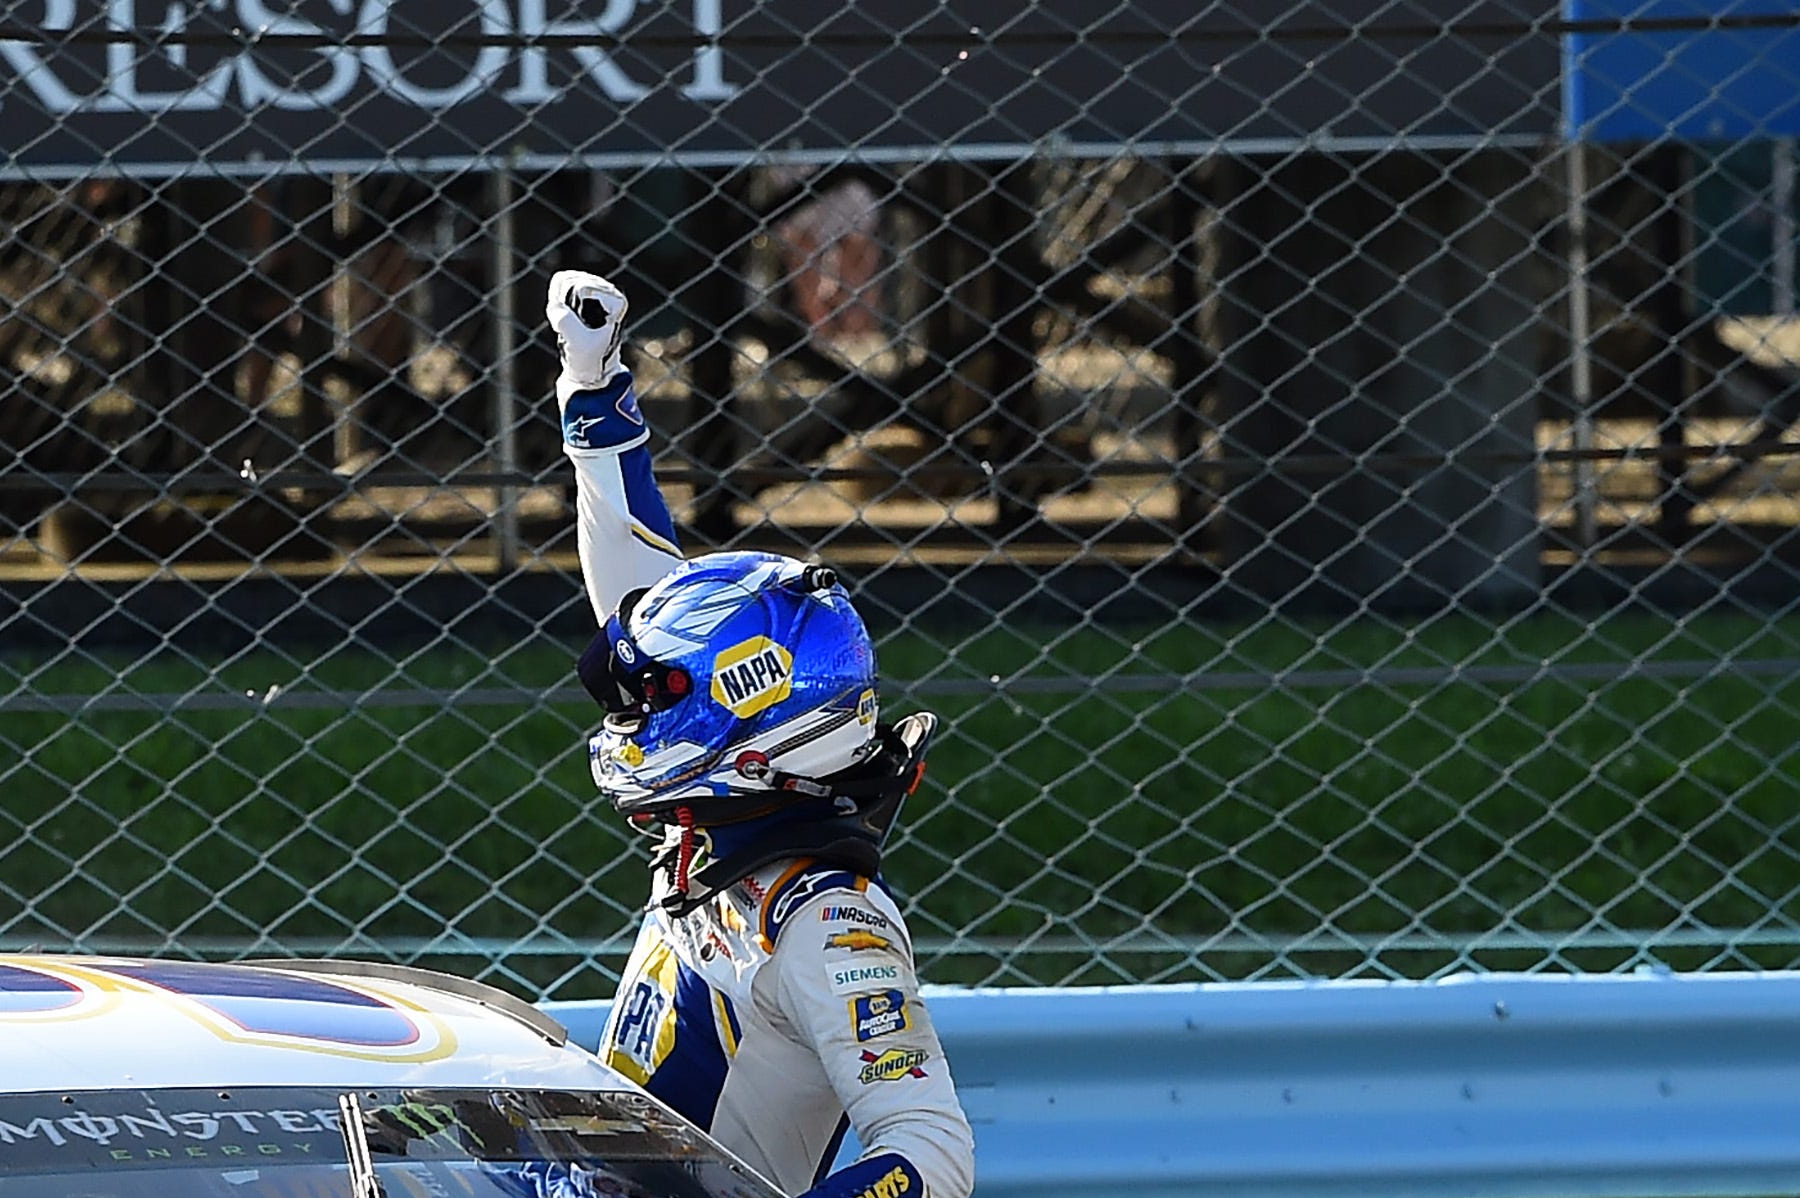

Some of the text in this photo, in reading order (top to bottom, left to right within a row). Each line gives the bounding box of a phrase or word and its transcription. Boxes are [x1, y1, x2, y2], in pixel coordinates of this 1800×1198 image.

[719, 650, 786, 704] NAPA
[835, 966, 898, 985] SIEMENS
[864, 1051, 925, 1082] SUNOCO
[110, 1143, 318, 1161] ENERGY
